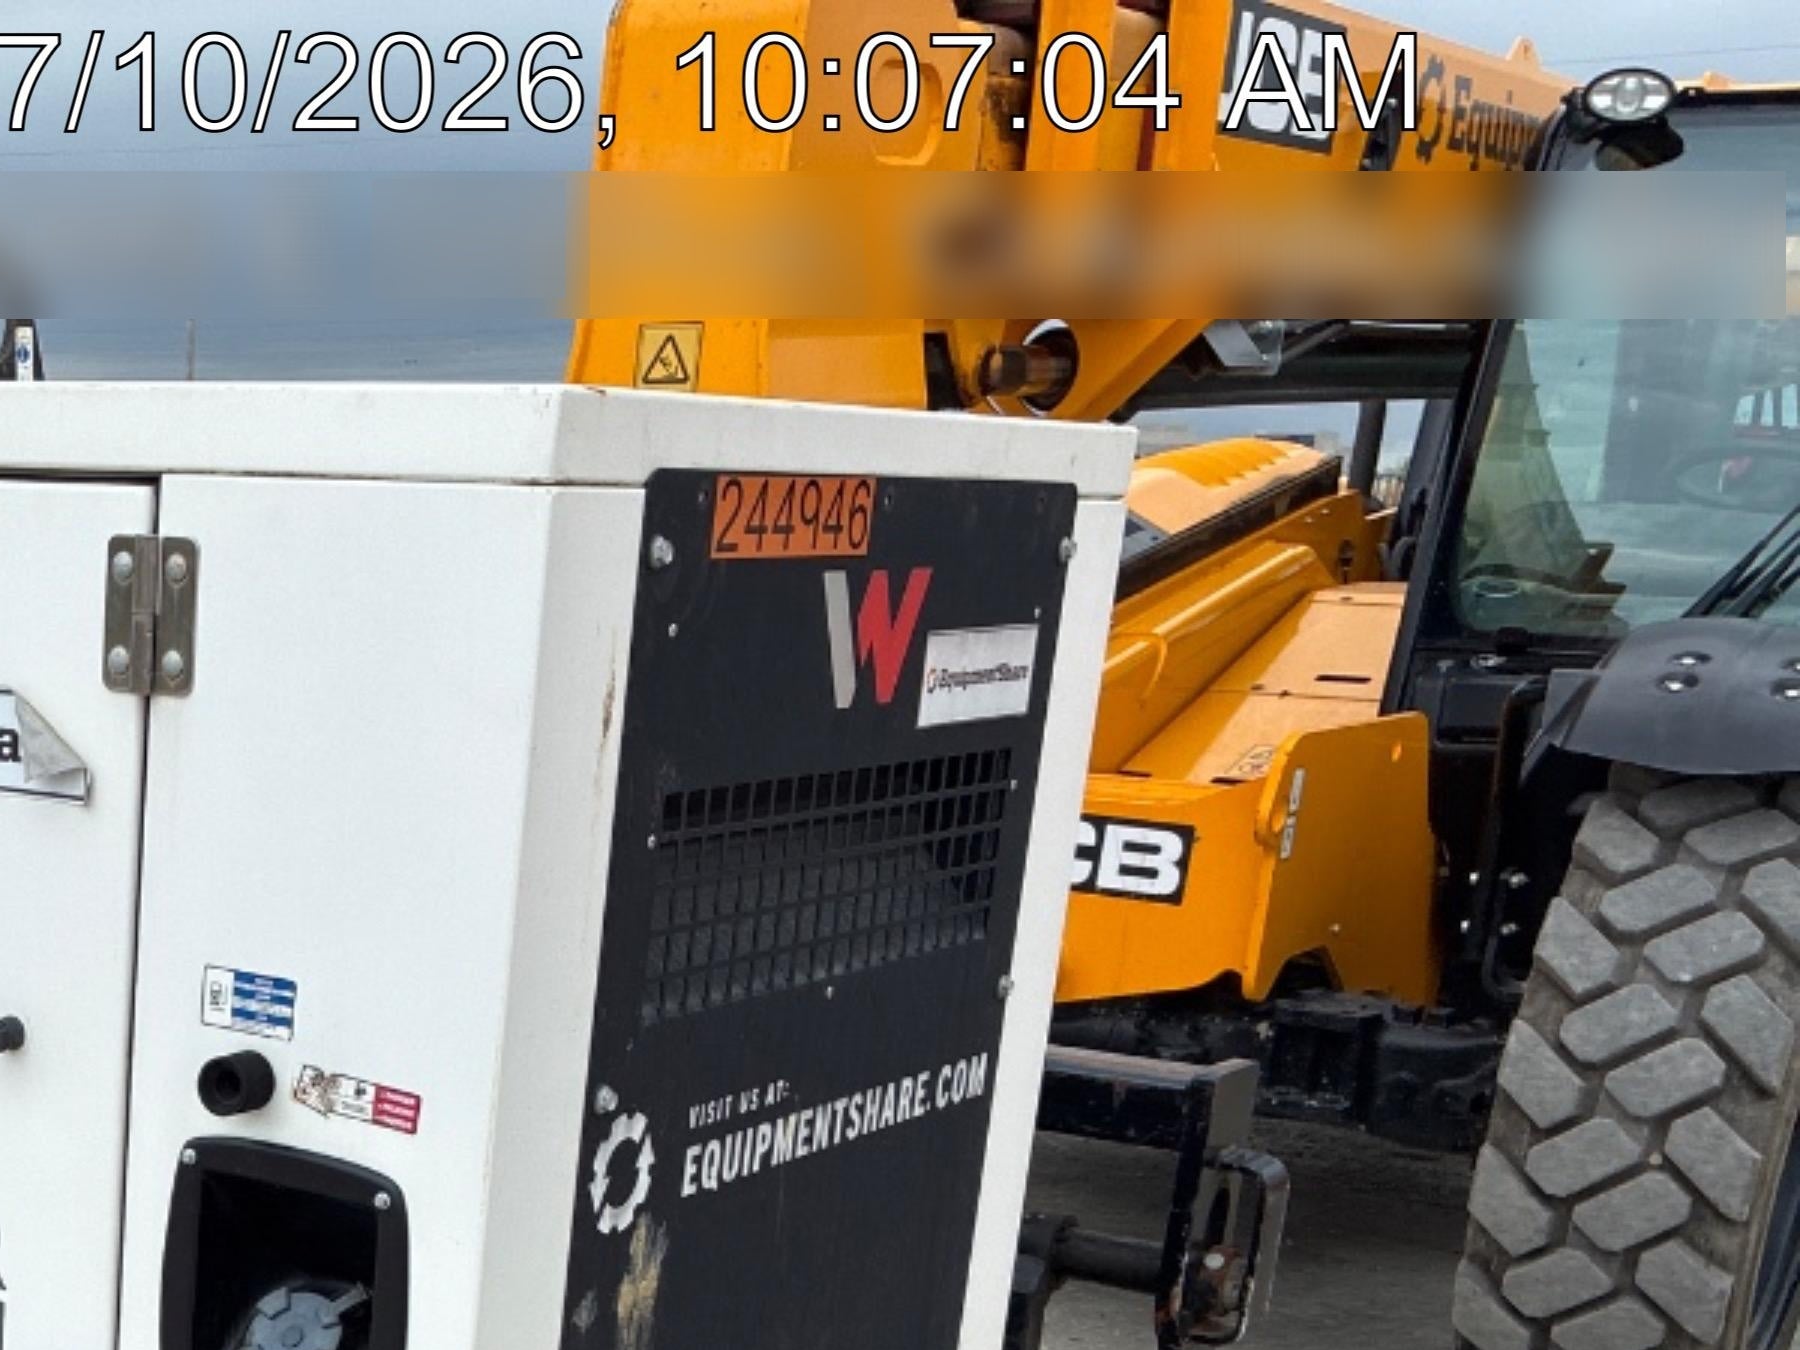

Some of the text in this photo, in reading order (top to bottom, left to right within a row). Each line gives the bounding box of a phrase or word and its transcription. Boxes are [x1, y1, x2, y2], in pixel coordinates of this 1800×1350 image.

[715, 477, 871, 553] 244946
[680, 1052, 988, 1198] EQUIPMENTSHARE.COM
[688, 1094, 733, 1130] VISIT
[739, 1087, 760, 1115] US
